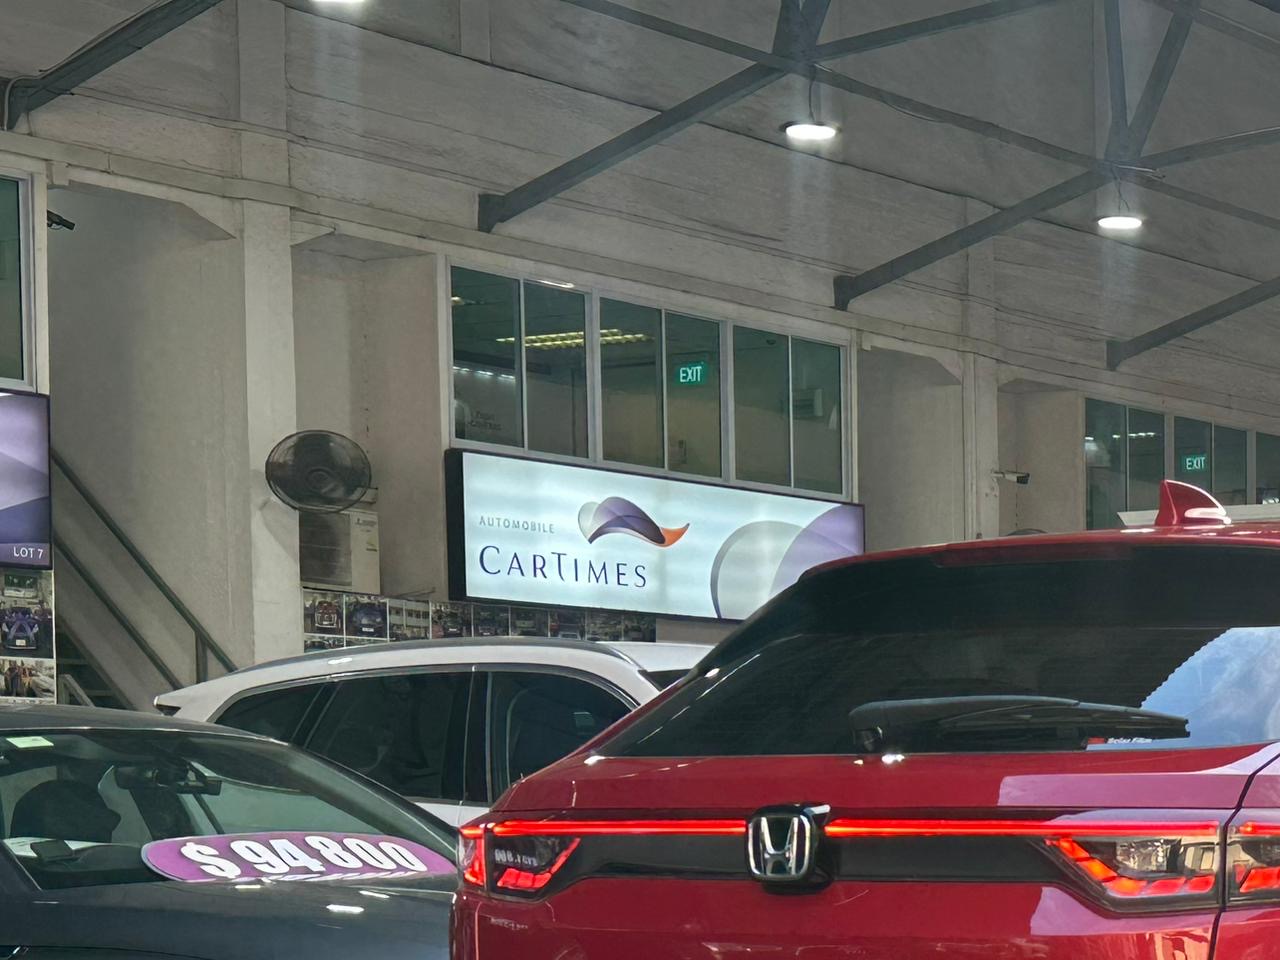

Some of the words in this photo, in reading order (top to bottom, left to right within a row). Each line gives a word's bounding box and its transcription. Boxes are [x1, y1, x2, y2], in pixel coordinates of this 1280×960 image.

[679, 365, 702, 383] EXIT
[1186, 456, 1206, 471] EXIT
[479, 515, 555, 534] AUTOMOBILE
[13, 546, 35, 559] LOT
[37, 548, 44, 560] 7
[180, 841, 242, 879] $
